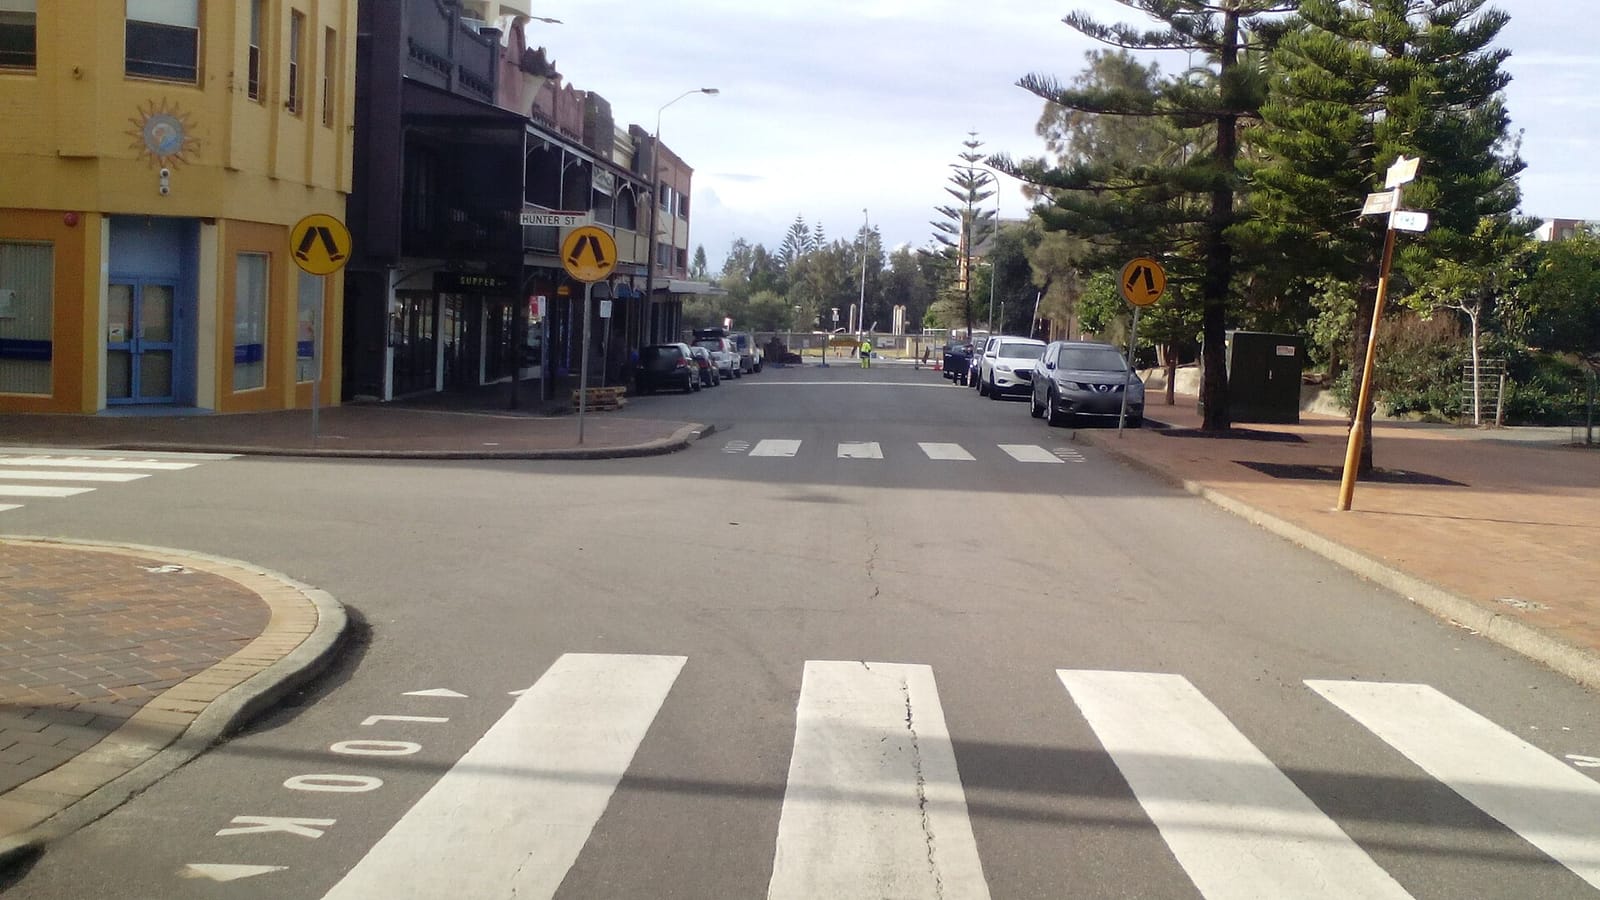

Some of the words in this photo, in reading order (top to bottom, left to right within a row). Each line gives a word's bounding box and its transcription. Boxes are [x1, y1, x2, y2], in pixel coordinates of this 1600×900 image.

[522, 214, 560, 225] HUNTER
[565, 216, 576, 225] ST
[459, 276, 496, 287] SUPPER
[216, 714, 450, 839] LOOK
